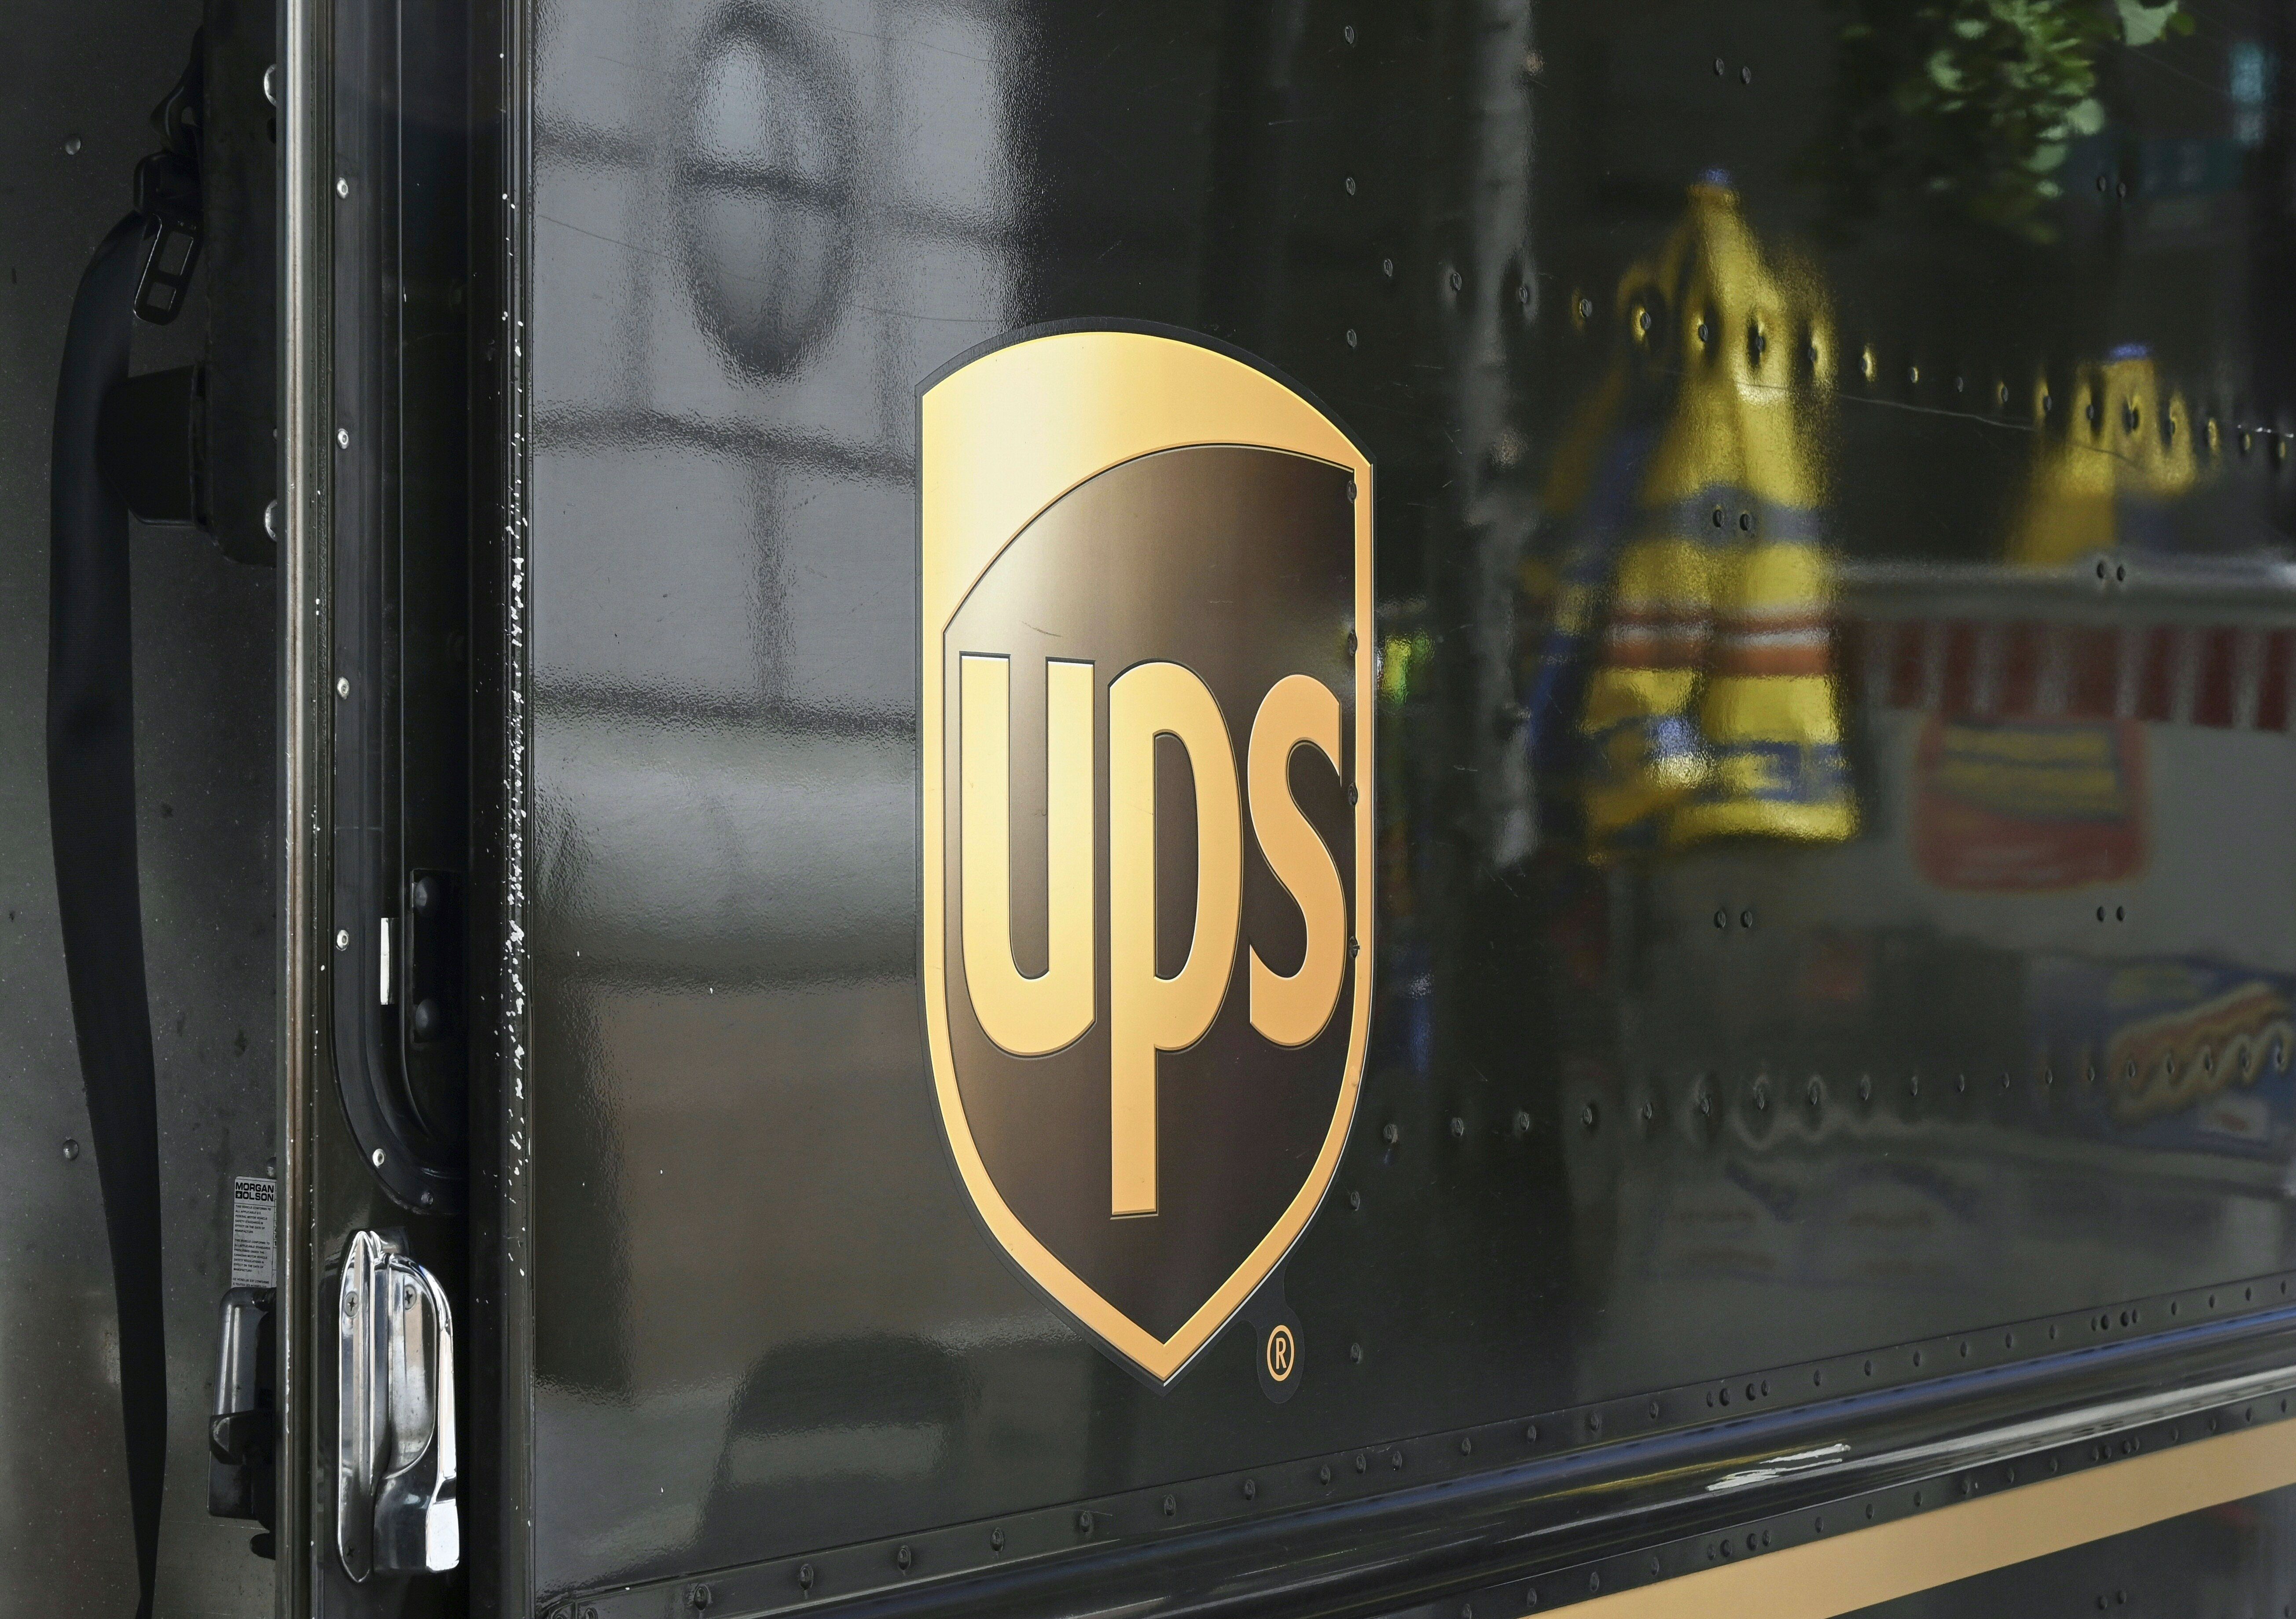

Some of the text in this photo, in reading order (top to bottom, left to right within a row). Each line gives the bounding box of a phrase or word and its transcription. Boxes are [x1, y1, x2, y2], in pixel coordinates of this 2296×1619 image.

[960, 654, 1346, 1216] ups
[236, 1182, 274, 1193] MORGAN
[243, 1191, 274, 1202] OLSON
